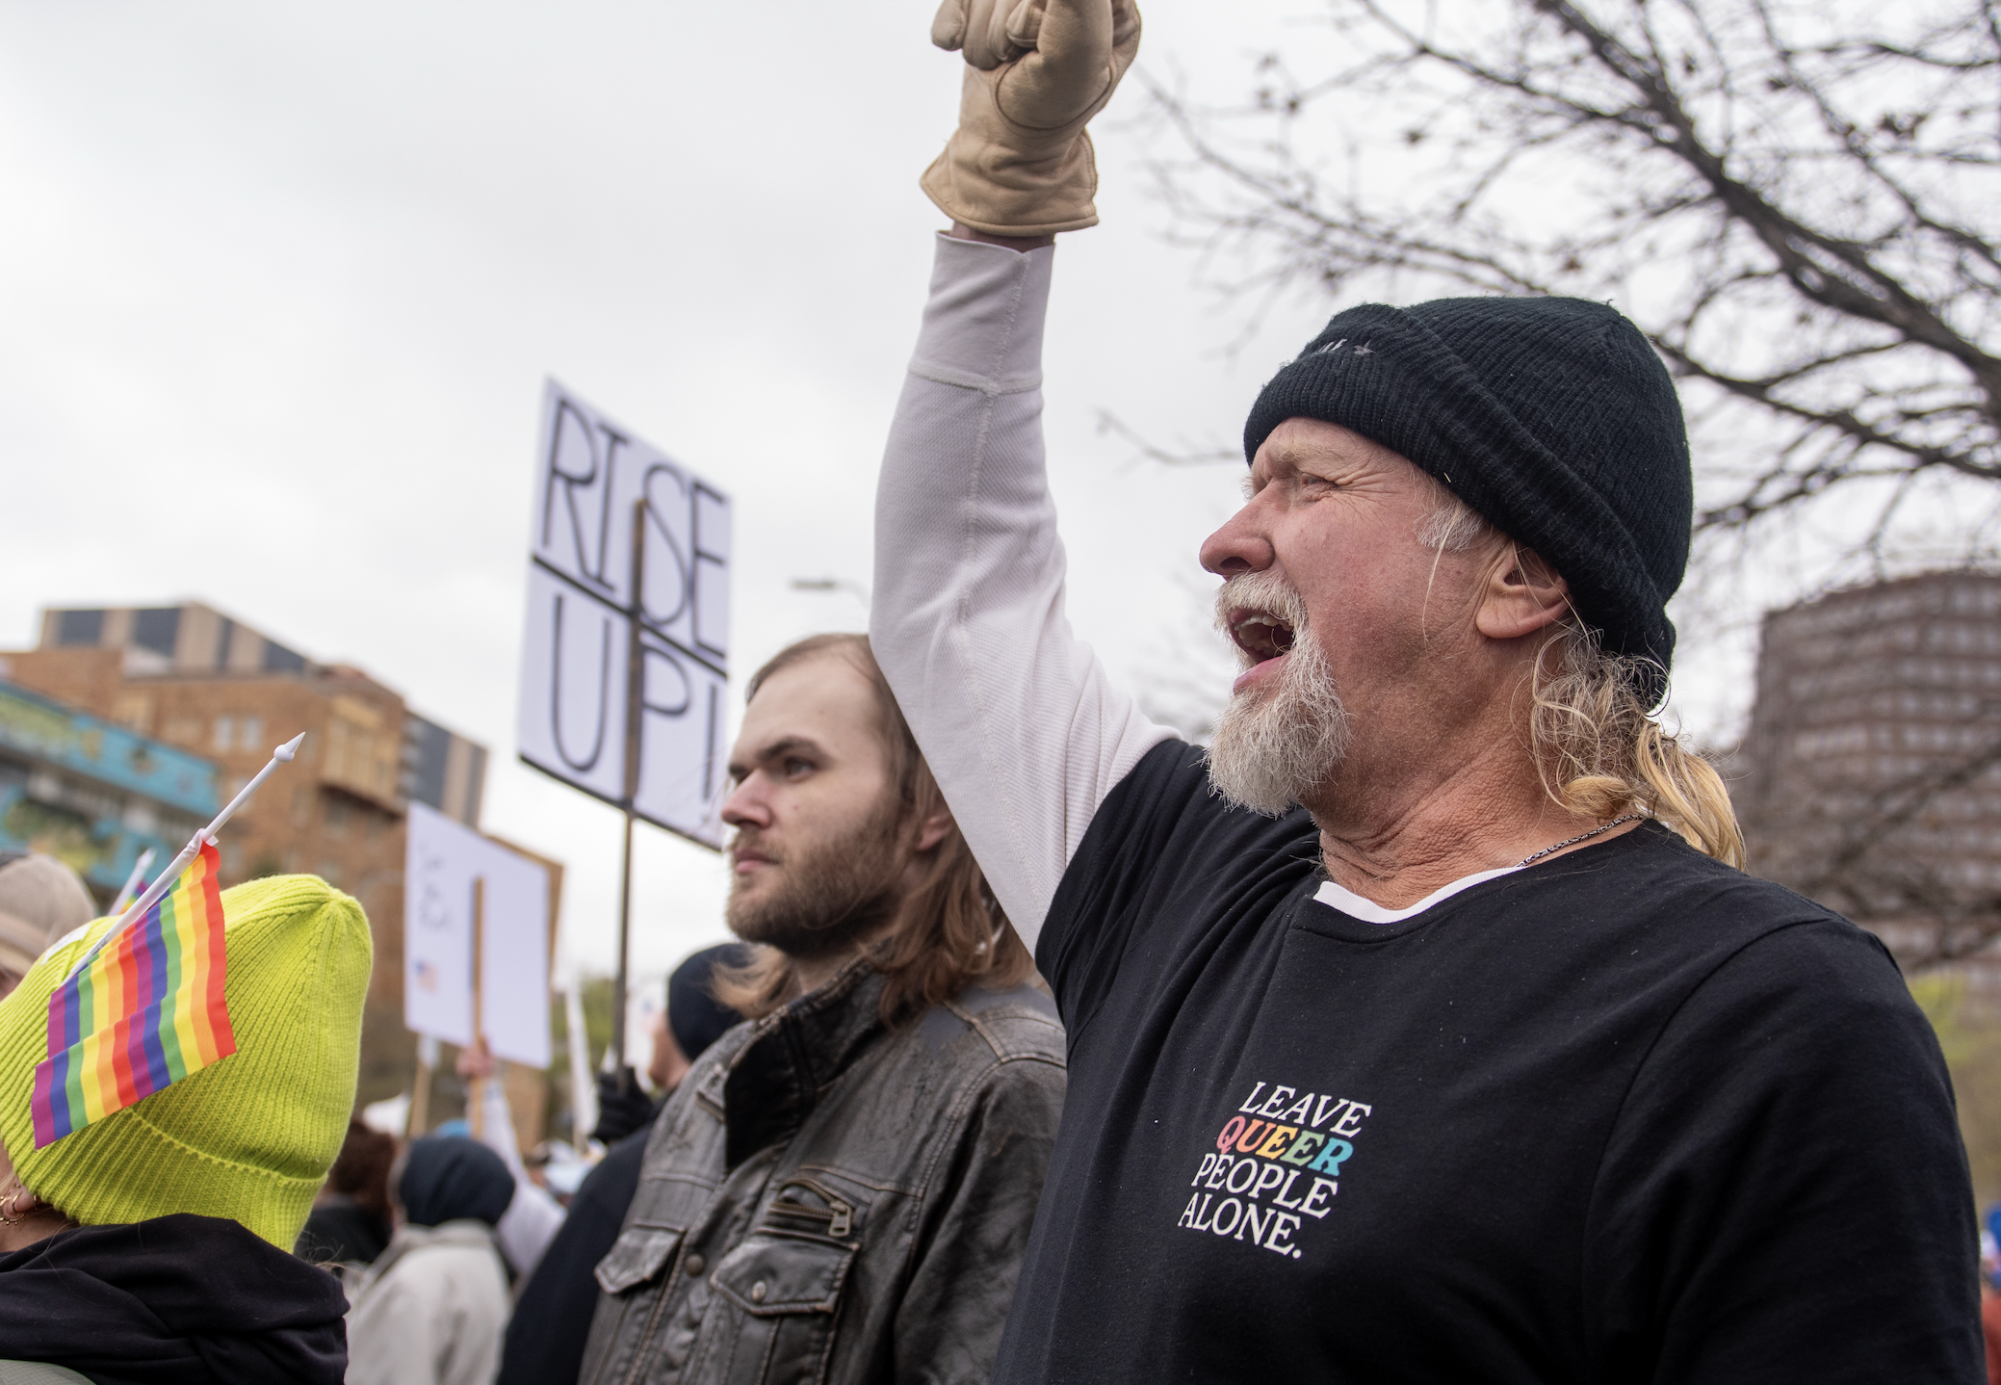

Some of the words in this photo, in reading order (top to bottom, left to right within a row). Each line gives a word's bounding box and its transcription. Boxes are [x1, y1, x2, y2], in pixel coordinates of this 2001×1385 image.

[543, 398, 727, 660] RISE
[1239, 1081, 1372, 1138] LEAVE
[1216, 1115, 1354, 1176] QUEER
[1191, 1153, 1338, 1219] PEOPLE
[1177, 1192, 1302, 1259] ALONE.
